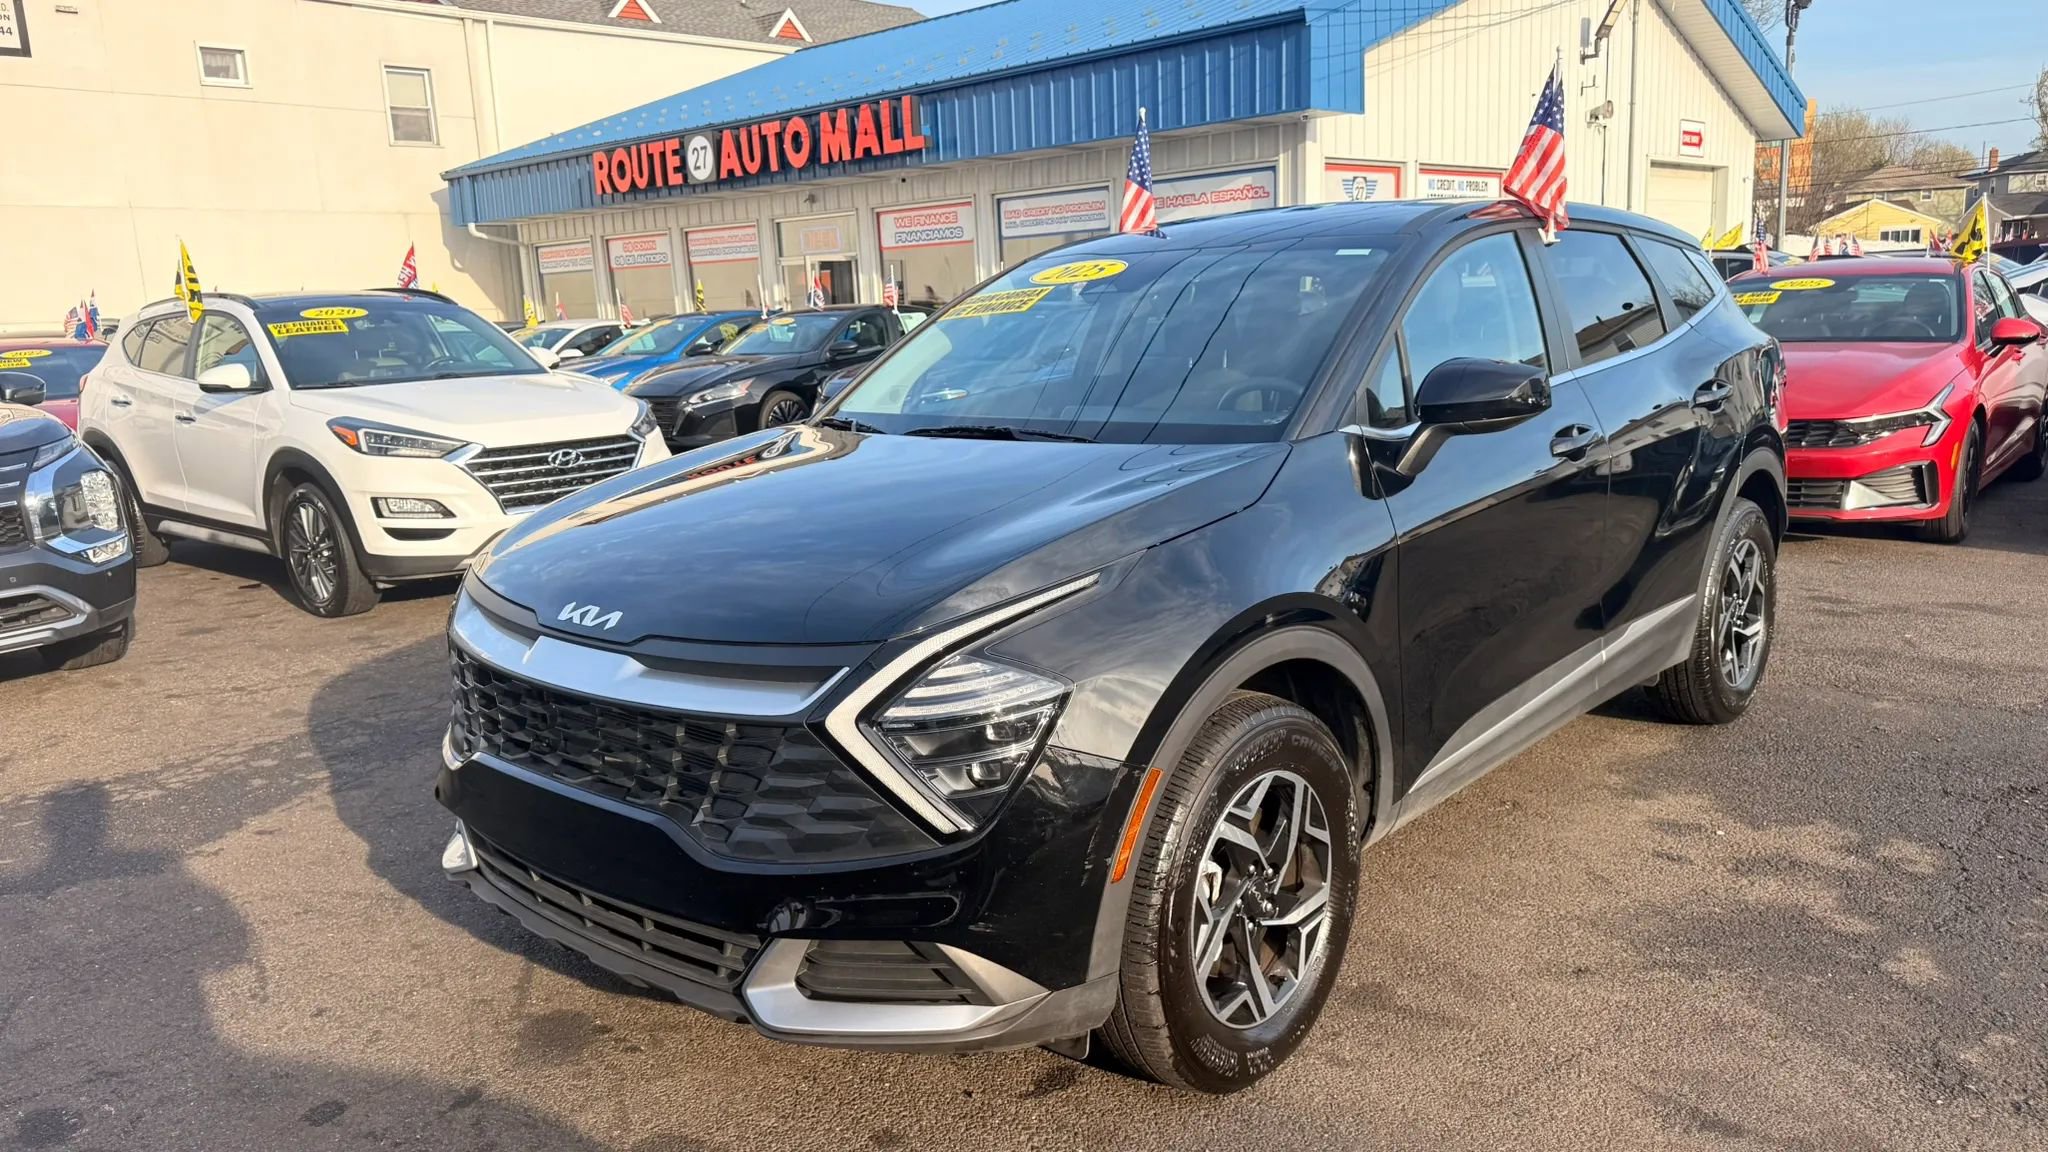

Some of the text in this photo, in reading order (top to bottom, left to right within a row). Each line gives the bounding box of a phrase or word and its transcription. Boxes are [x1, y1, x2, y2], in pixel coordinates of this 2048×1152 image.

[592, 95, 925, 195] ROUTE 27 AUTO MALL
[1355, 187, 1364, 200] 27
[1428, 179, 1436, 190] NO
[1457, 180, 1465, 191] NO
[1465, 180, 1489, 192] PROBLEM
[1166, 192, 1208, 207] HABLA
[1211, 184, 1270, 204] ESPAÑOL
[1005, 200, 1106, 220] BAD CREDIT NO PROBLEM
[894, 211, 957, 228] WE FINANCE
[895, 226, 964, 244] FINANCIAMOS
[634, 240, 657, 252] DOWN
[625, 254, 636, 265] DE
[636, 252, 668, 264] ANTICIPO
[1040, 263, 1116, 281] 2025
[315, 308, 357, 317] 2020
[966, 297, 1036, 315] FINANCE
[277, 325, 343, 335] LEATHER
[292, 320, 338, 328] FINANCE
[557, 601, 623, 630] KIA
